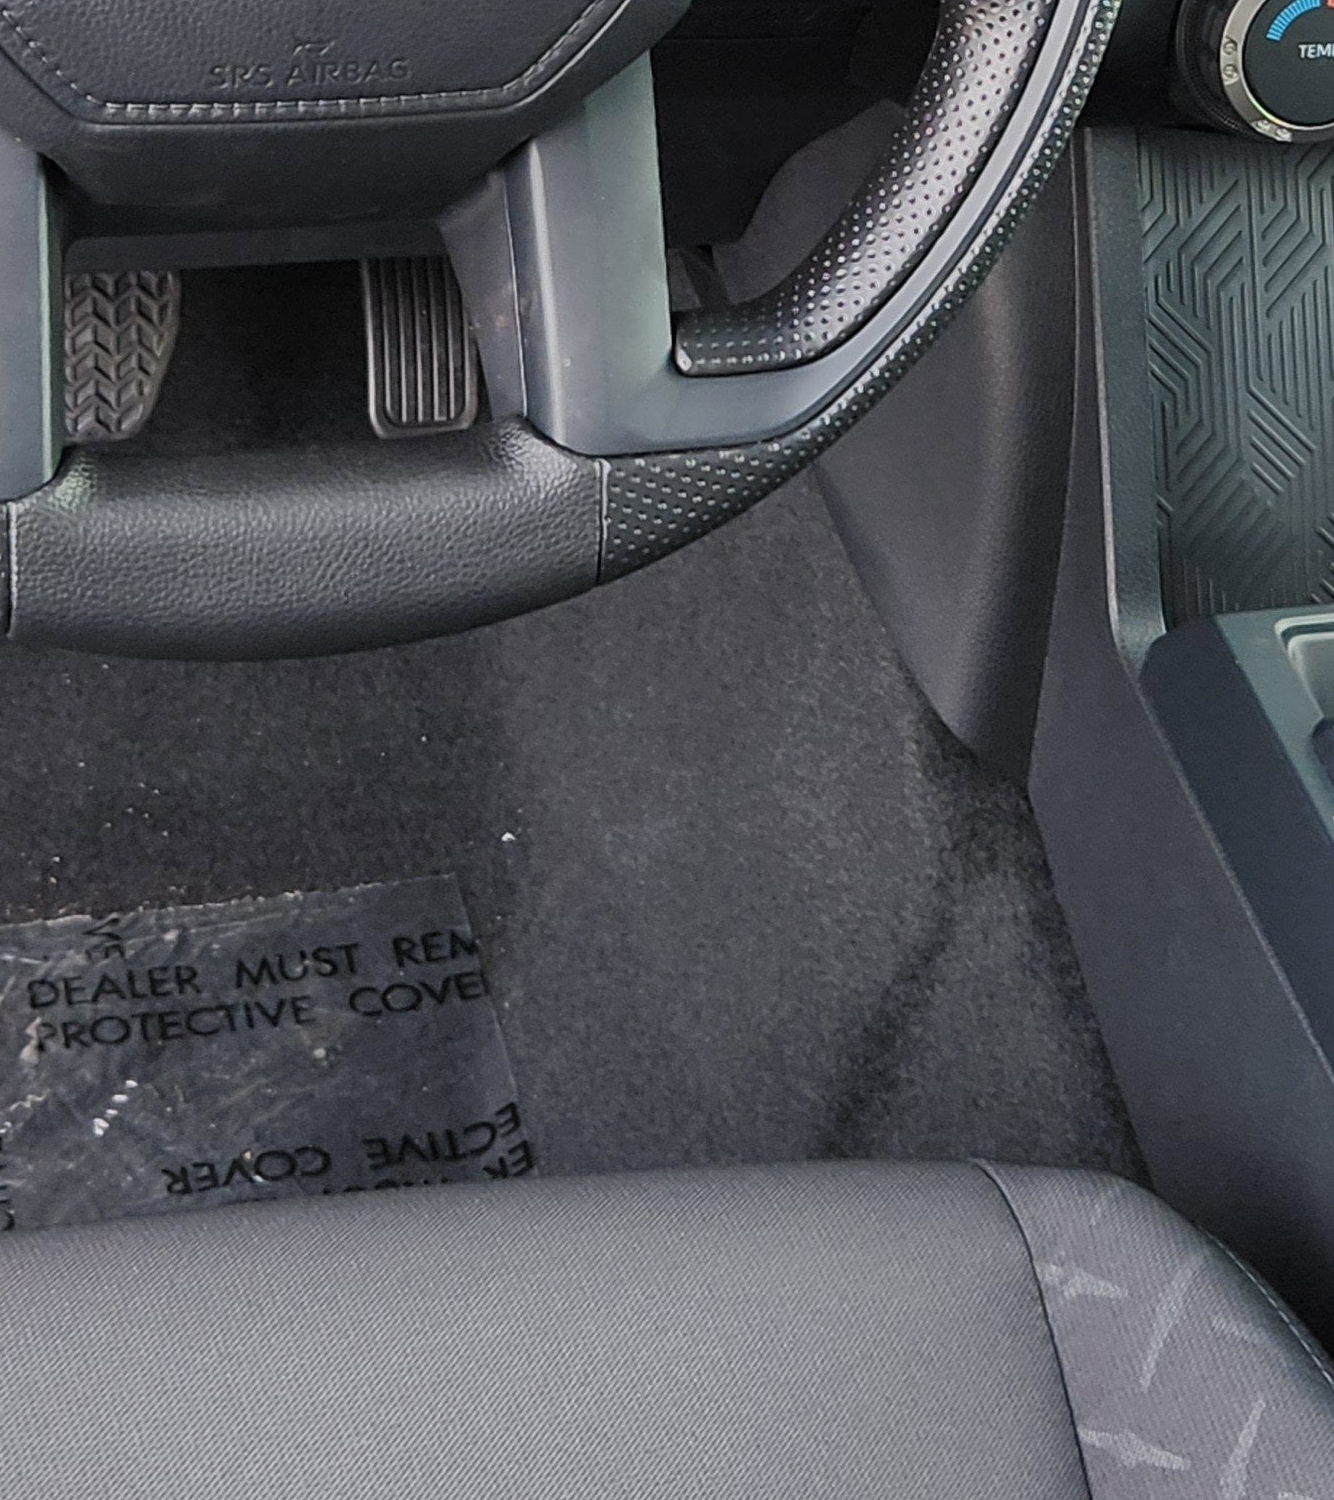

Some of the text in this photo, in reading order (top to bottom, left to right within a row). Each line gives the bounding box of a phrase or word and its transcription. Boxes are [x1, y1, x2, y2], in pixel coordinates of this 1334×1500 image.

[208, 56, 412, 89] SRS AIRBAG
[26, 964, 201, 1011] DEALER
[235, 942, 361, 990] MUST
[35, 971, 491, 1053] PROTECTIVE COVE
[161, 1144, 334, 1196] COVER
